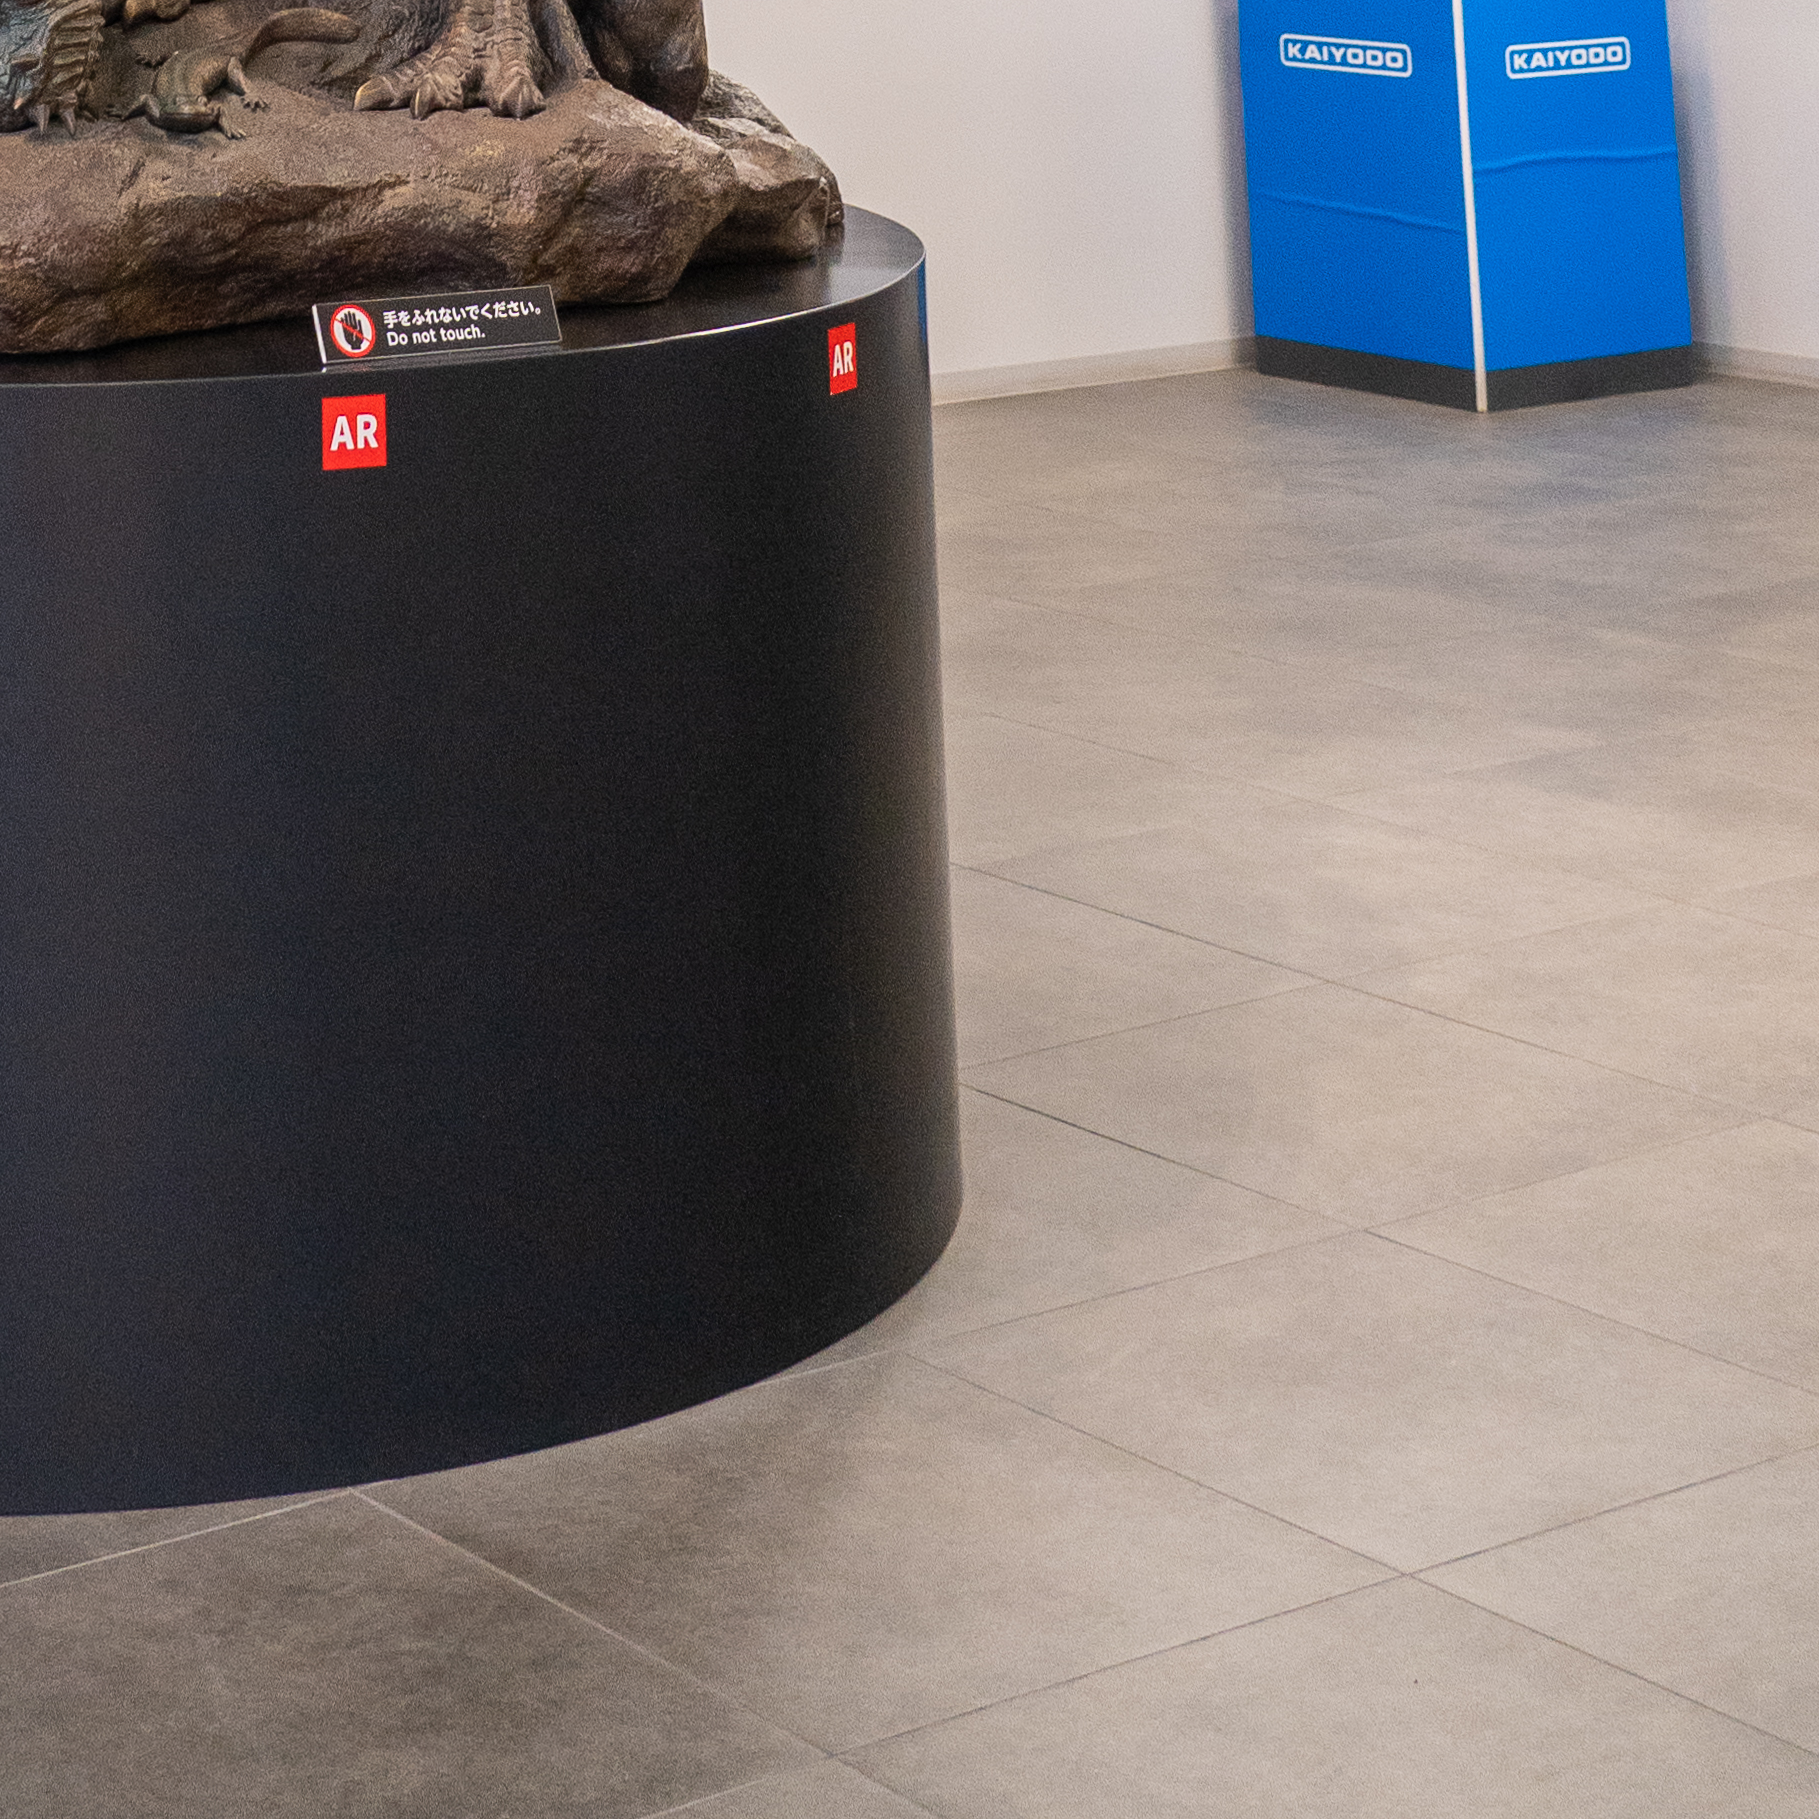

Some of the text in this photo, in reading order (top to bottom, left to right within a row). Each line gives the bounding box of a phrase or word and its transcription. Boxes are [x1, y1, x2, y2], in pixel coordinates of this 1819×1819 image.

[1287, 41, 1404, 70] KAIYODO
[1512, 45, 1623, 70] KAIYODO
[383, 301, 541, 329] 手をふれないでください。
[387, 324, 486, 347] Do not touch.
[832, 341, 854, 378] AR
[330, 413, 379, 452] AR
